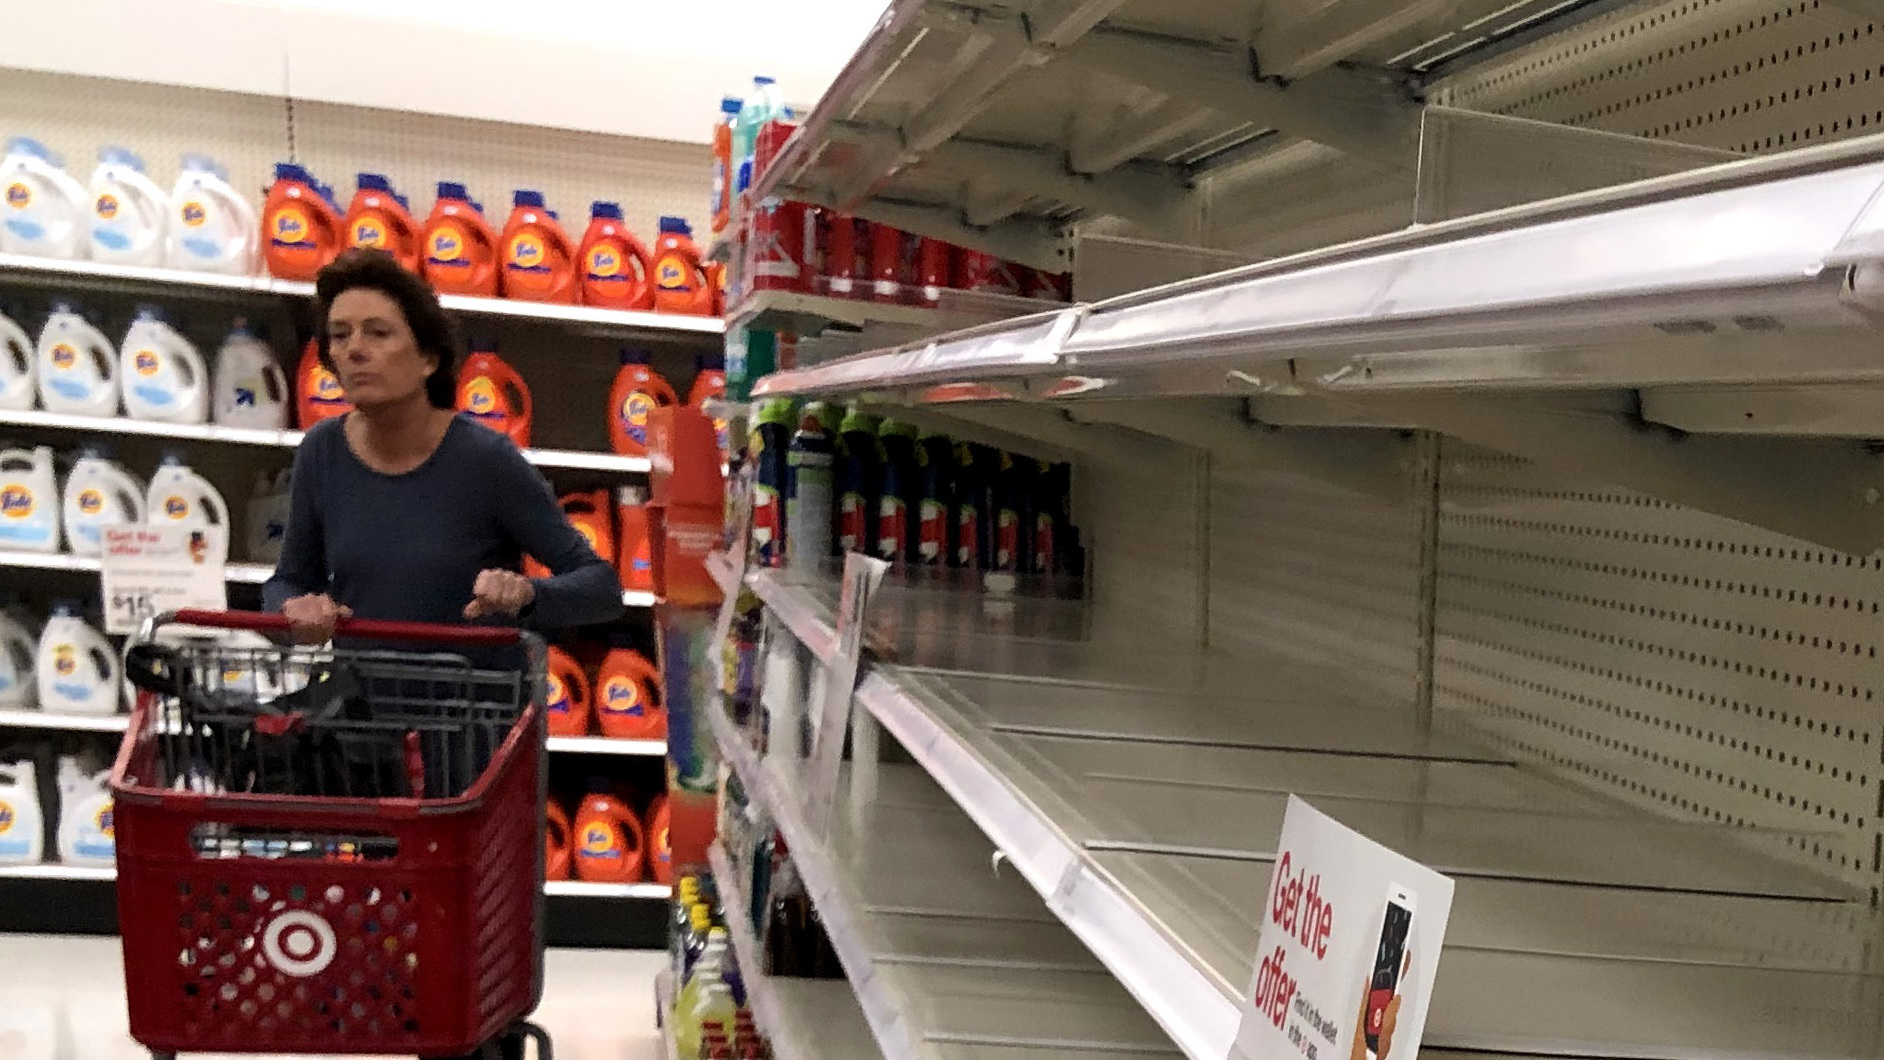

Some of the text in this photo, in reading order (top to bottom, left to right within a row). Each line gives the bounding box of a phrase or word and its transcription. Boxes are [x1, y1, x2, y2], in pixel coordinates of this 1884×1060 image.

[1272, 851, 1333, 961] Get the
[1255, 945, 1298, 1031] offer
